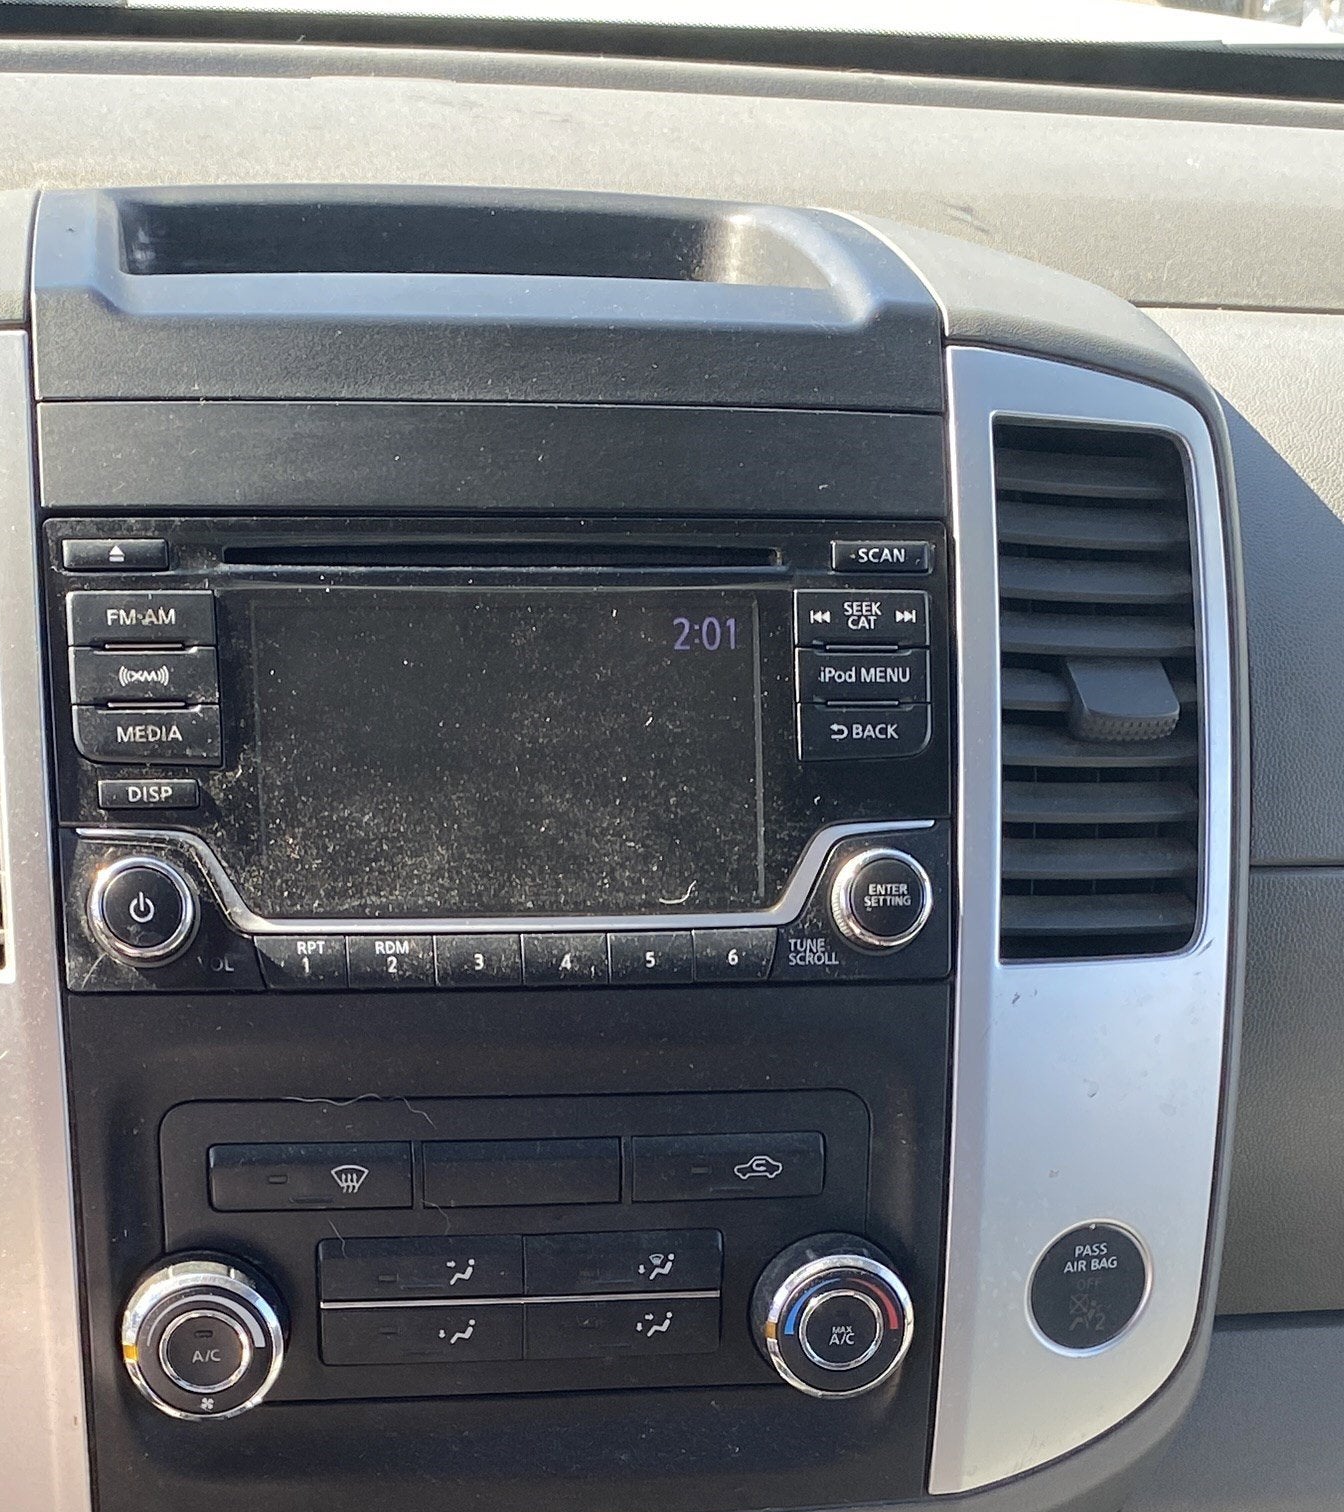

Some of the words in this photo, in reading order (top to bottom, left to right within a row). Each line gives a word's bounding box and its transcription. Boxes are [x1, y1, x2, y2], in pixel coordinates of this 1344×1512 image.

[858, 548, 906, 563] SCAN
[843, 601, 882, 616] SEEK
[847, 616, 877, 630] CAT
[672, 616, 739, 651] 2:01
[820, 667, 856, 683] iPod
[860, 667, 910, 683] MENU
[117, 725, 183, 743] MEDIA
[852, 723, 899, 739] BACK
[127, 785, 174, 803] DISP
[868, 883, 908, 896] ENTER
[864, 895, 912, 908] SETTING
[296, 940, 326, 955] RPT
[375, 940, 410, 955] RDM
[788, 938, 826, 953] TUNE
[473, 953, 485, 971] 3
[560, 952, 572, 971] 4
[645, 950, 656, 968] 5
[728, 948, 739, 966] 6
[788, 952, 840, 966] SCROLL
[301, 956, 310, 974] 1
[387, 956, 398, 974] 2
[1074, 1243, 1107, 1257] PASS
[1064, 1259, 1086, 1273] AIR
[1090, 1256, 1117, 1270] BAG
[832, 1325, 853, 1334] MAX
[829, 1333, 855, 1346] A/C
[192, 1349, 222, 1364] A/C
